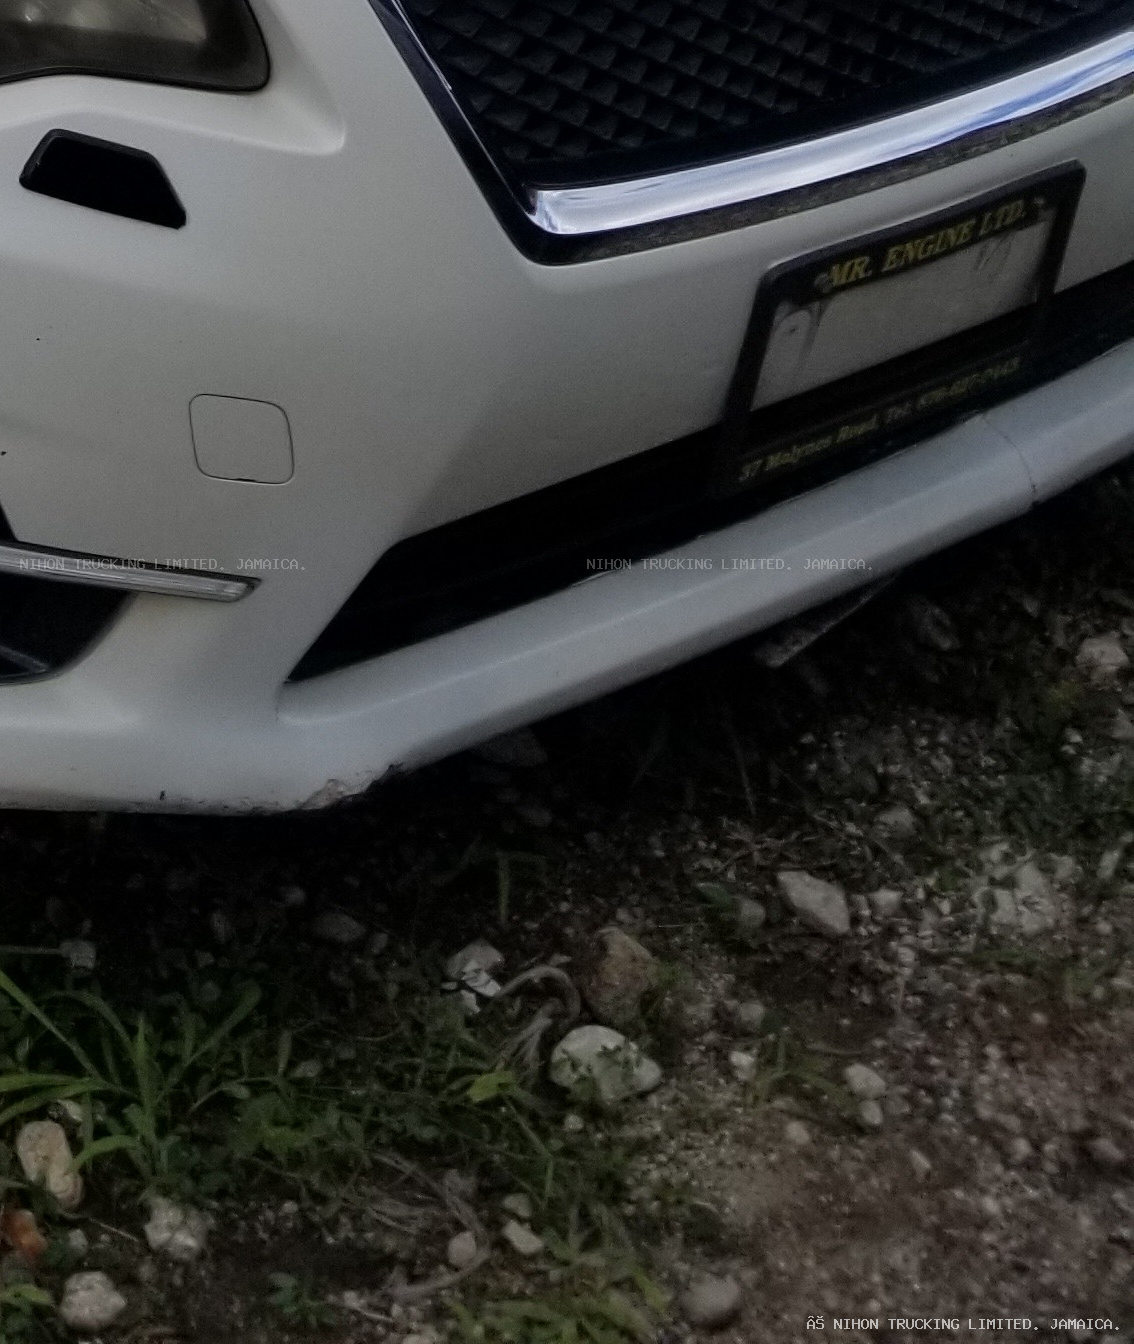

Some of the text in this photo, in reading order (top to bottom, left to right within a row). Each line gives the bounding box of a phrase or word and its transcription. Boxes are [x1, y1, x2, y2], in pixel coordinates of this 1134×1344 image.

[829, 198, 1027, 288] MR. ENGINE LTD.
